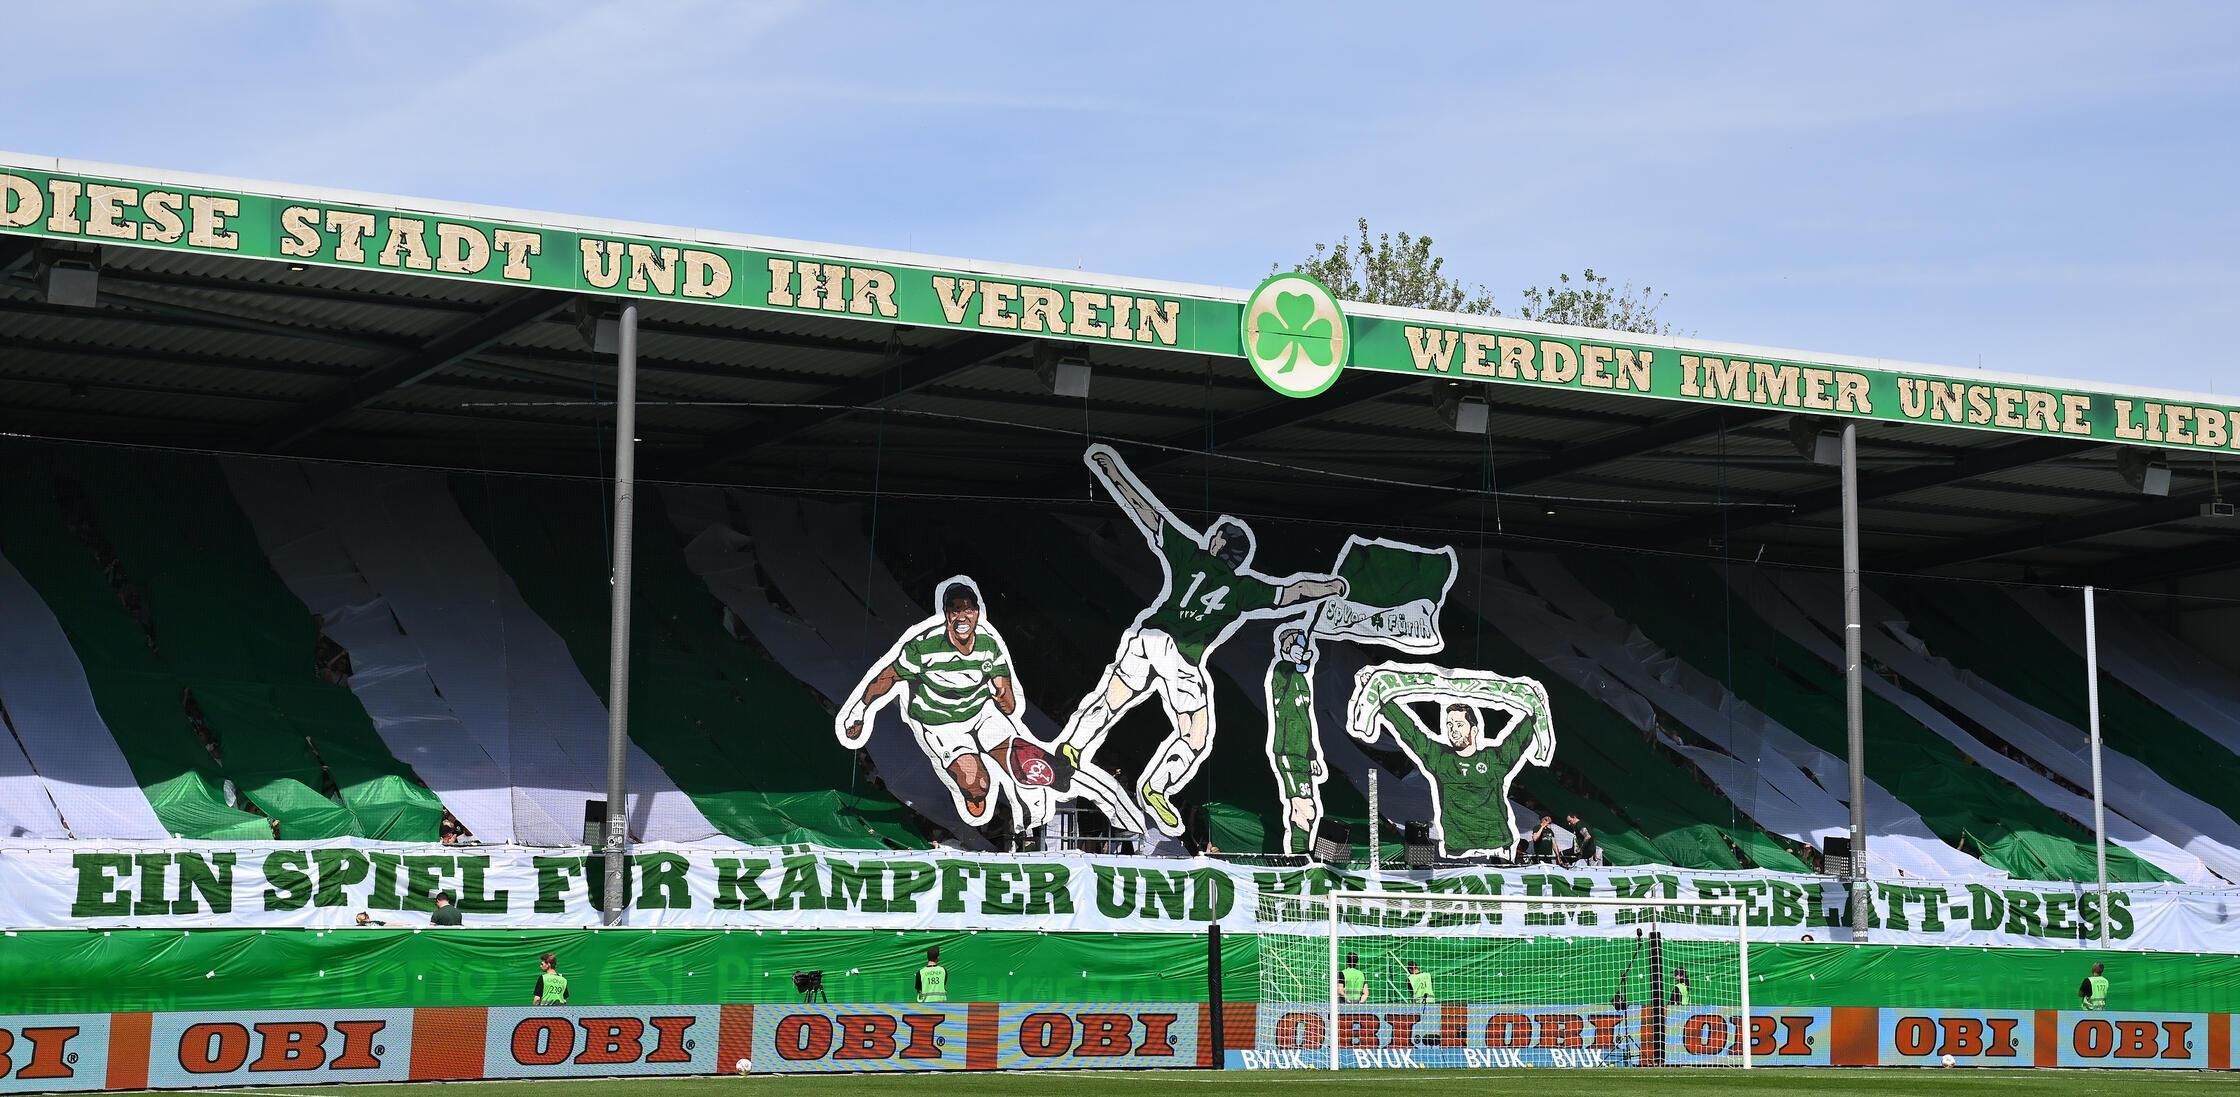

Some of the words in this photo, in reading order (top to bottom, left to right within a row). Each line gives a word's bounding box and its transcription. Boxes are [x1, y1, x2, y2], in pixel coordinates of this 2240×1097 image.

[0, 172, 241, 250] DIESE
[281, 205, 541, 281] STADT
[579, 237, 734, 300] UND
[766, 257, 899, 318] IHR
[932, 275, 1181, 346] VEREIN
[1403, 325, 1654, 393] WERDEN
[1679, 354, 1873, 415] IMMER
[1898, 376, 2092, 436] UNSERE
[1179, 571, 1230, 615] 14
[1387, 613, 1431, 639] Fürth
[71, 852, 237, 917] EIN
[262, 848, 508, 914] SPIEL
[712, 845, 1075, 915] KÄMPFER
[1092, 864, 1235, 922] UND
[1253, 868, 1505, 928] HELDEN
[1521, 874, 1598, 926] IM
[1608, 874, 2135, 940] KLEEBLATT-DRESS
[549, 985, 563, 995] 239
[927, 976, 940, 985] 183
